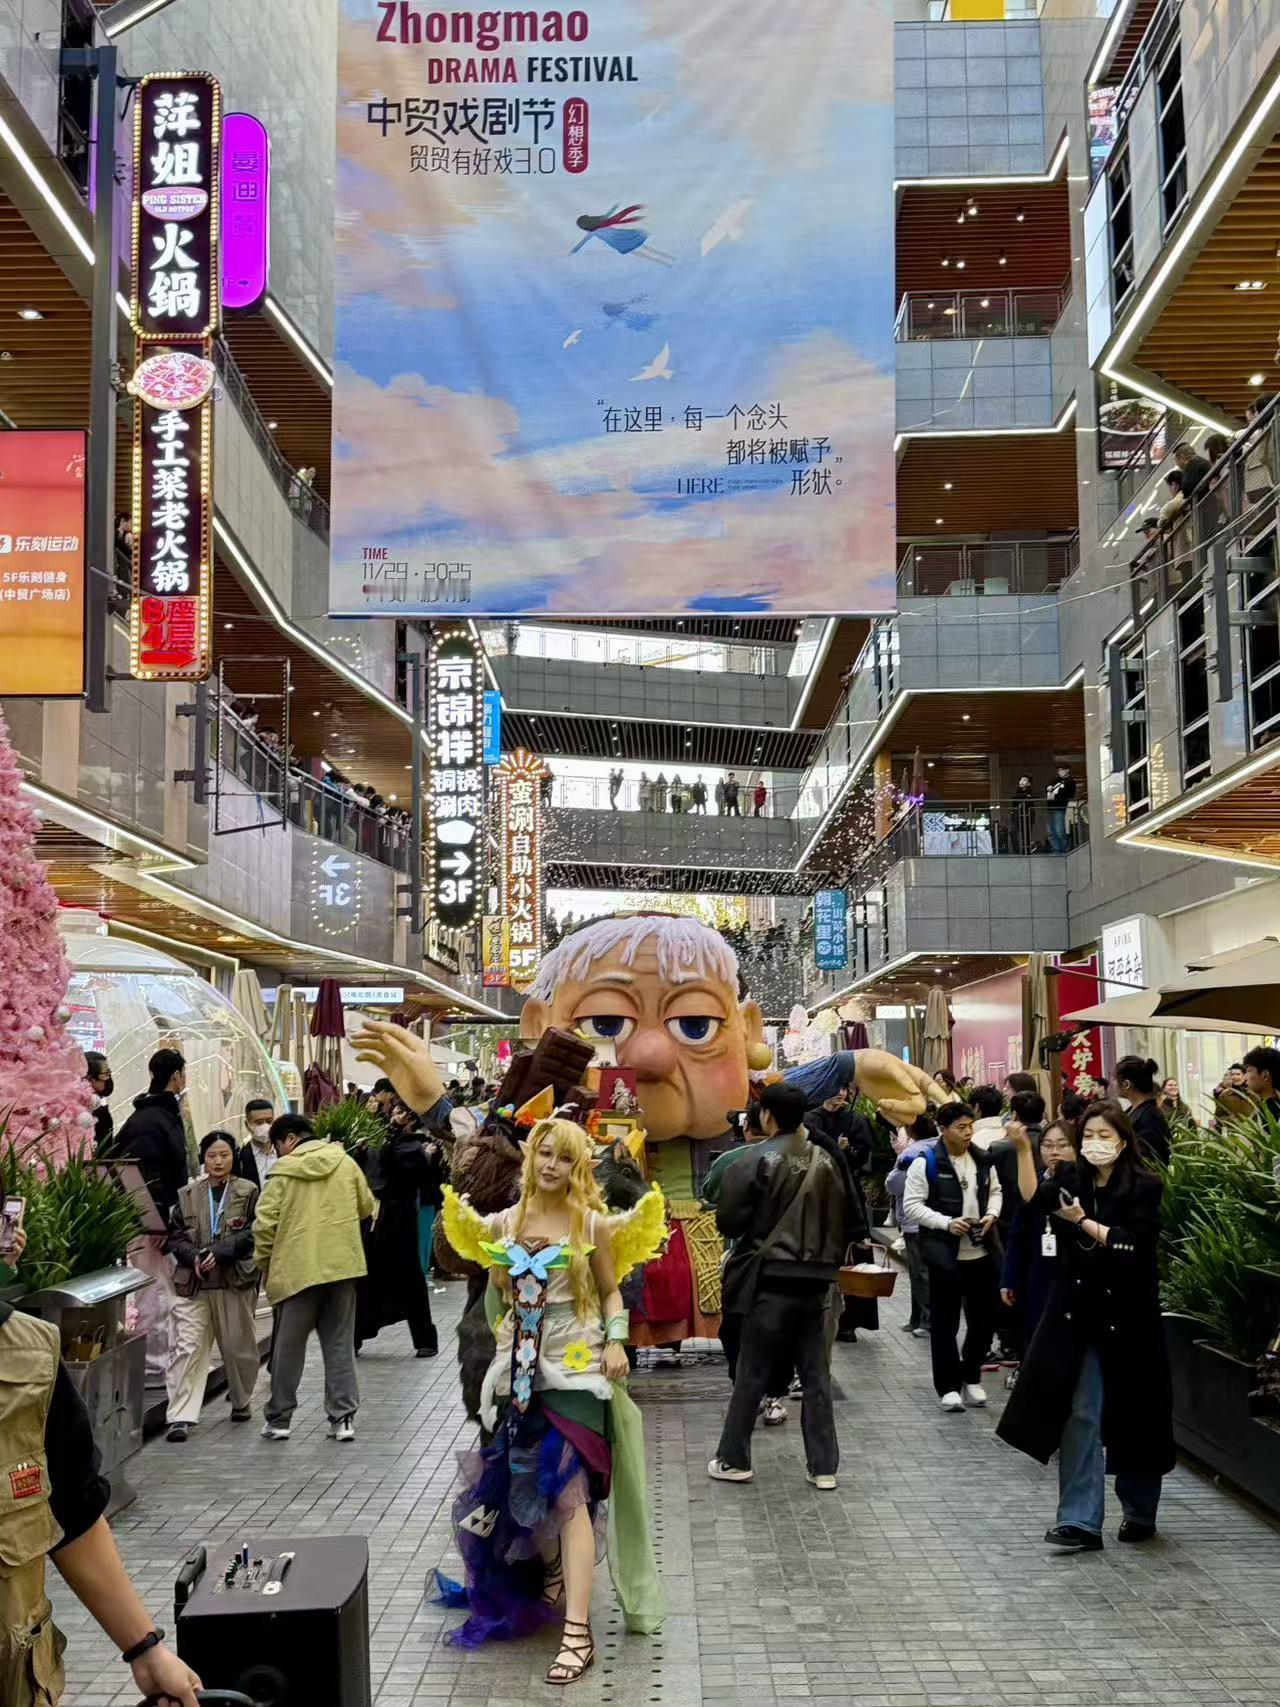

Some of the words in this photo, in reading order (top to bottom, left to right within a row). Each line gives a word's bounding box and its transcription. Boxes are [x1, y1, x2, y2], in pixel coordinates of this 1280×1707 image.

[376, 1, 589, 51] Zhongmao
[427, 57, 518, 84] DRAMA
[527, 56, 638, 83] FESTIVAL
[367, 97, 556, 145] 中贸戏剧节
[150, 91, 203, 186] 萍姐
[567, 103, 585, 168] 幻想季
[409, 145, 556, 175] 贸贸有好戏3.0
[143, 194, 167, 205] PING
[169, 194, 208, 204] SISTER
[677, 477, 725, 495] HERE
[150, 410, 191, 593] 手工菜老火锅
[15, 536, 80, 552] 乐刻运动
[362, 547, 389, 560] TIME
[3, 571, 68, 584] 5F乐刻健身
[362, 562, 408, 580] 11/29
[424, 562, 472, 580] 2025
[0, 588, 71, 602] (中贸广场店)
[437, 879, 474, 905] 3F
[510, 948, 537, 967] 5F
